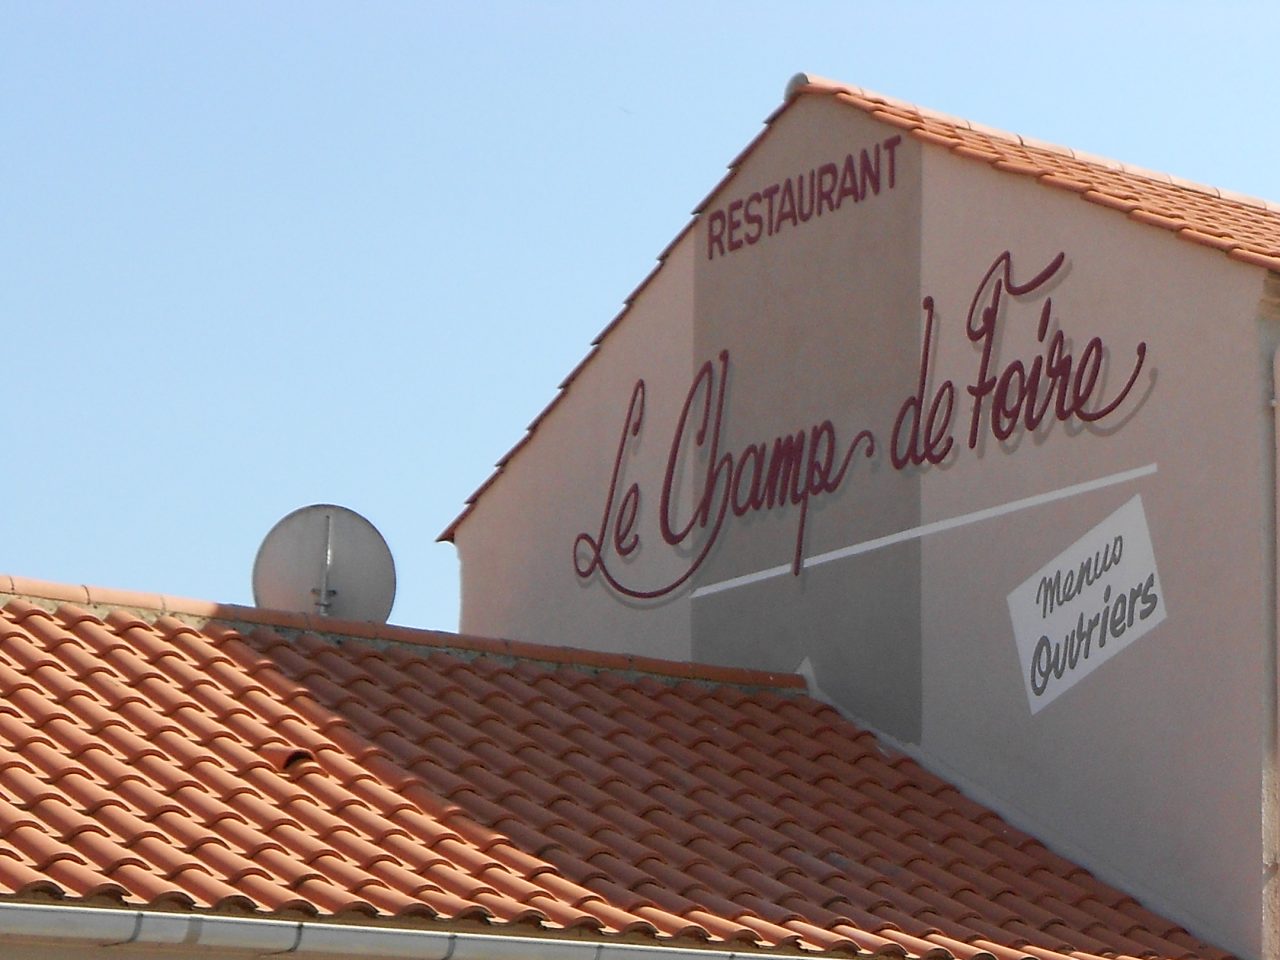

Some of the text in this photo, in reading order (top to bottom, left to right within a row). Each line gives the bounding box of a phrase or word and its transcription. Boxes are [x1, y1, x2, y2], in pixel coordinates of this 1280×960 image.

[707, 135, 901, 260] RESTAURANT
[573, 378, 645, 578] Le
[891, 296, 955, 472] de
[967, 250, 1147, 449] Foire
[1030, 572, 1158, 696] Ouvriers
